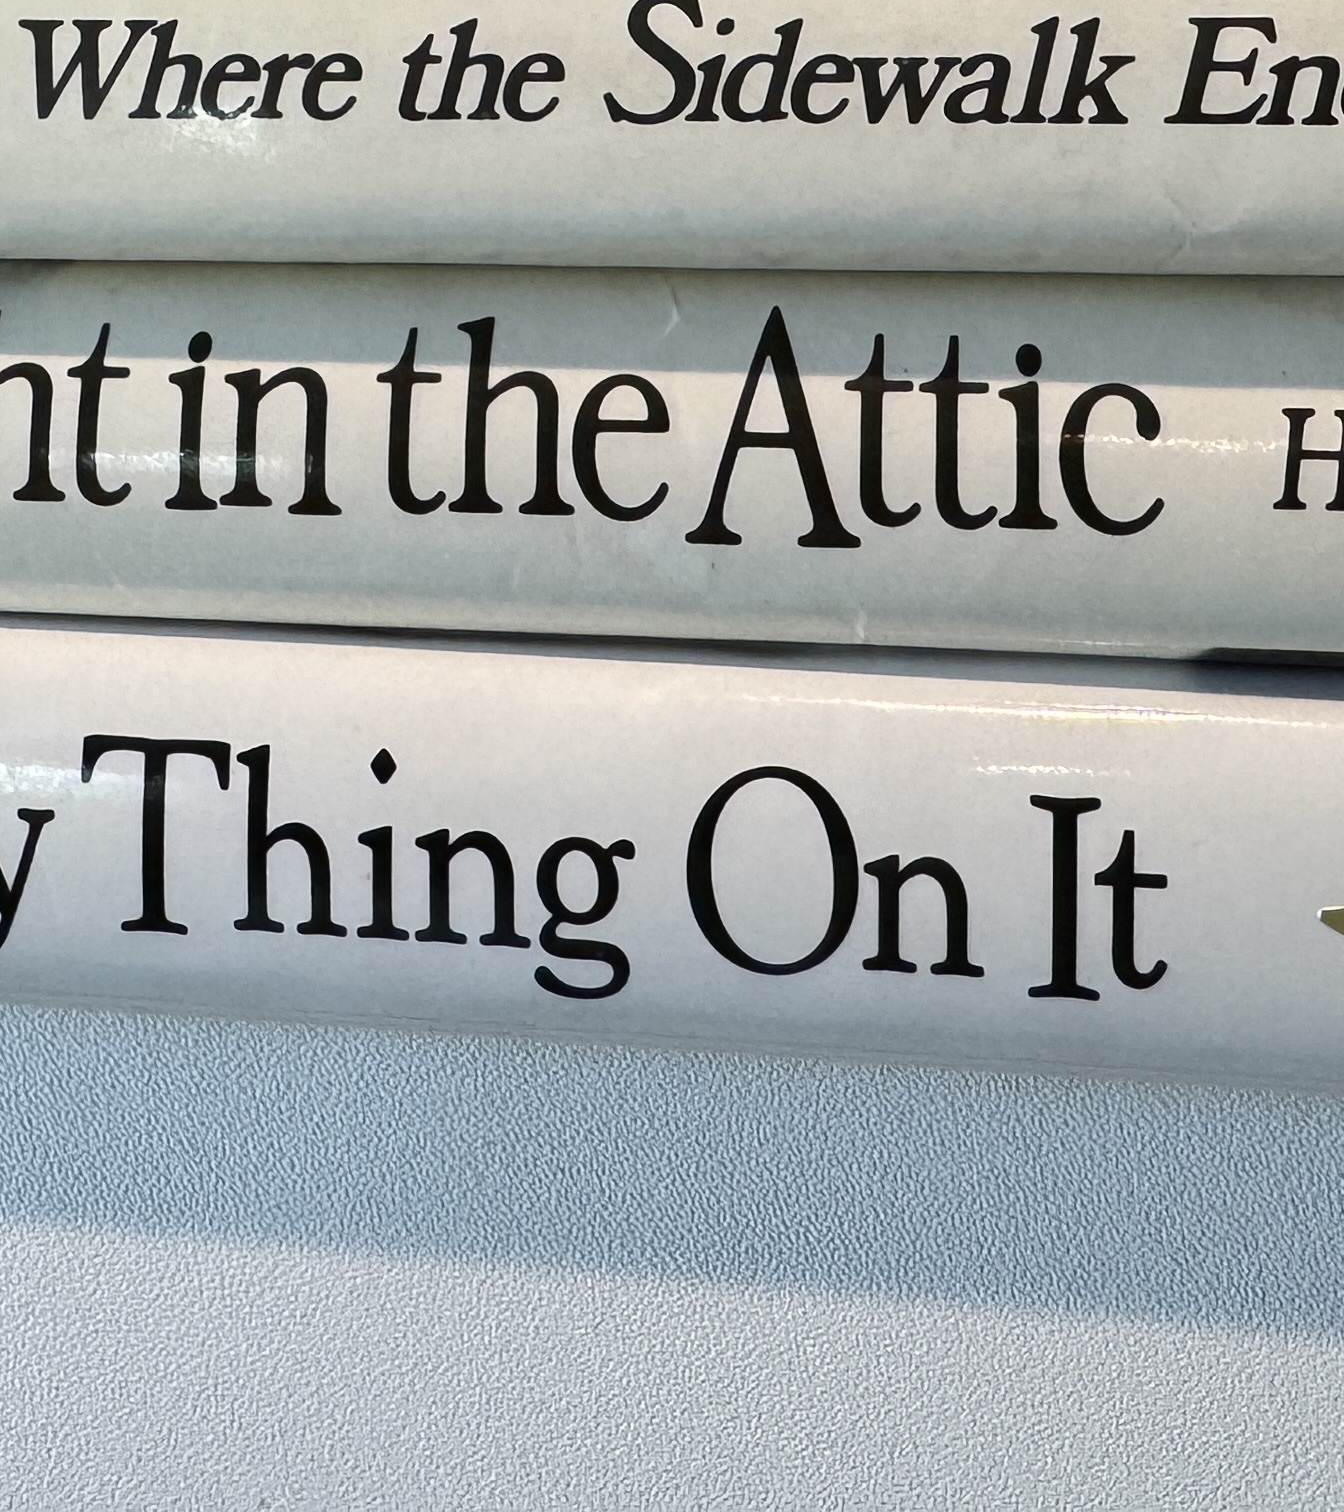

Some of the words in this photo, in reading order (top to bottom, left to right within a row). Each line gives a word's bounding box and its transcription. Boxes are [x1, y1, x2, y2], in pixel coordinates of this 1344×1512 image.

[19, 20, 362, 120] Where
[399, 18, 565, 122] the
[165, 331, 342, 515] in
[377, 317, 669, 521] the
[685, 305, 1164, 548] Attic
[82, 735, 635, 999] Thing
[687, 766, 984, 977] On
[1028, 795, 1167, 1001] It
